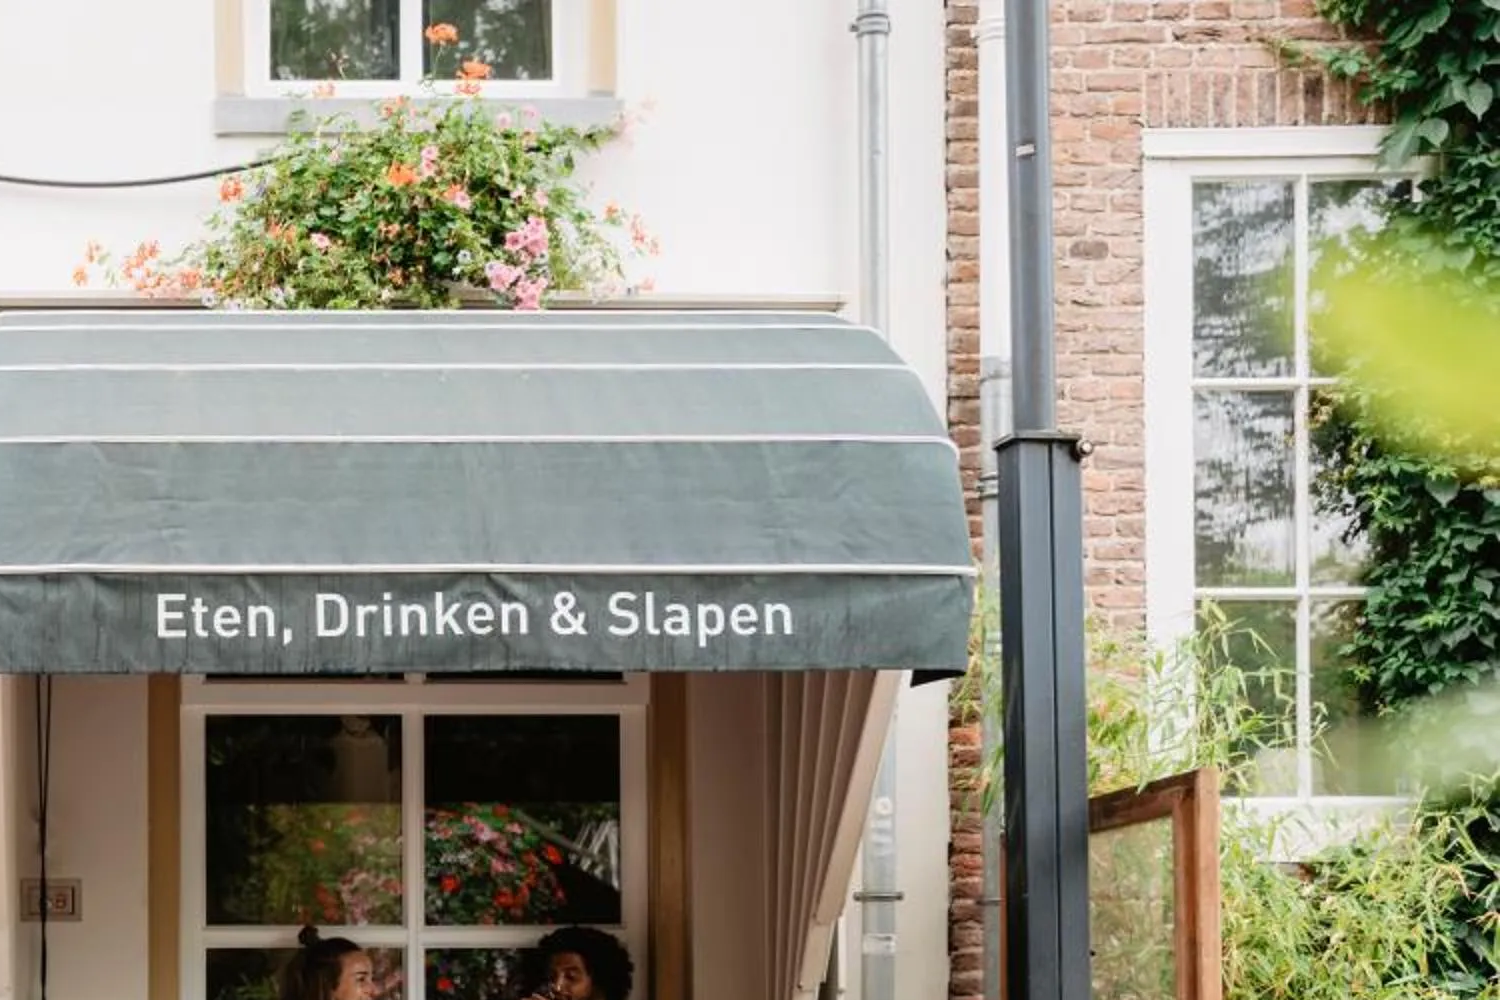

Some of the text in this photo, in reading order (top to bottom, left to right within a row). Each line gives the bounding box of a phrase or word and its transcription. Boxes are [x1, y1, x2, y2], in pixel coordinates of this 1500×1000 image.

[156, 591, 794, 648] Eten, Drinken & Slapen
